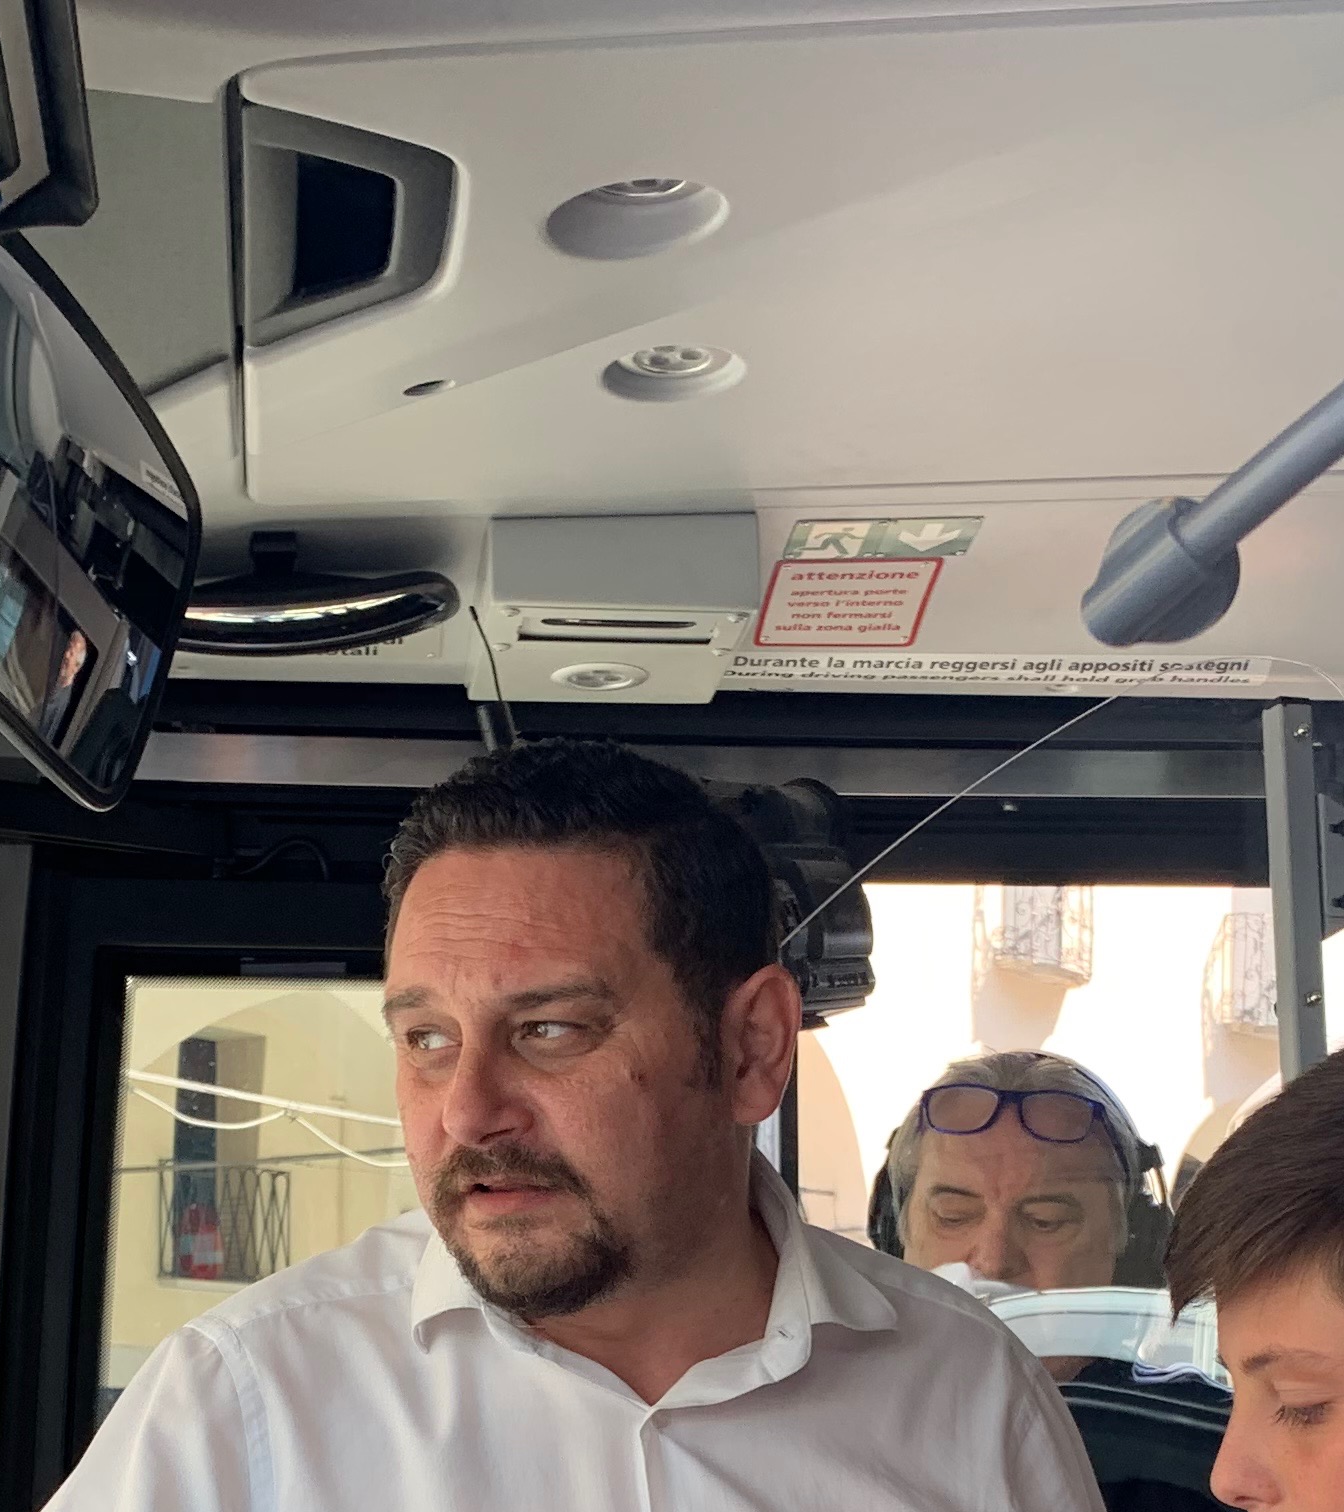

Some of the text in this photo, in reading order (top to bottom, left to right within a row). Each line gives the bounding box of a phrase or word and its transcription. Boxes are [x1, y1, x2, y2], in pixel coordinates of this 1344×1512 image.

[790, 570, 920, 581] attenzione
[790, 588, 908, 598] apertura porte
[787, 600, 830, 608] verso
[826, 611, 893, 619] fermarsi
[775, 623, 812, 631] sulla
[857, 623, 901, 633] gialla
[732, 655, 820, 669] Durante
[827, 656, 845, 669] la
[852, 656, 923, 670] marcia
[929, 658, 1017, 673] reggersi
[1023, 658, 1063, 674] agli
[1068, 658, 1154, 675] appositi
[723, 669, 794, 679] During
[800, 671, 876, 680] driving
[881, 674, 1001, 682] passengers
[1006, 674, 1057, 682] shall
[1061, 675, 1108, 683] hold
[1169, 675, 1251, 684] handles
